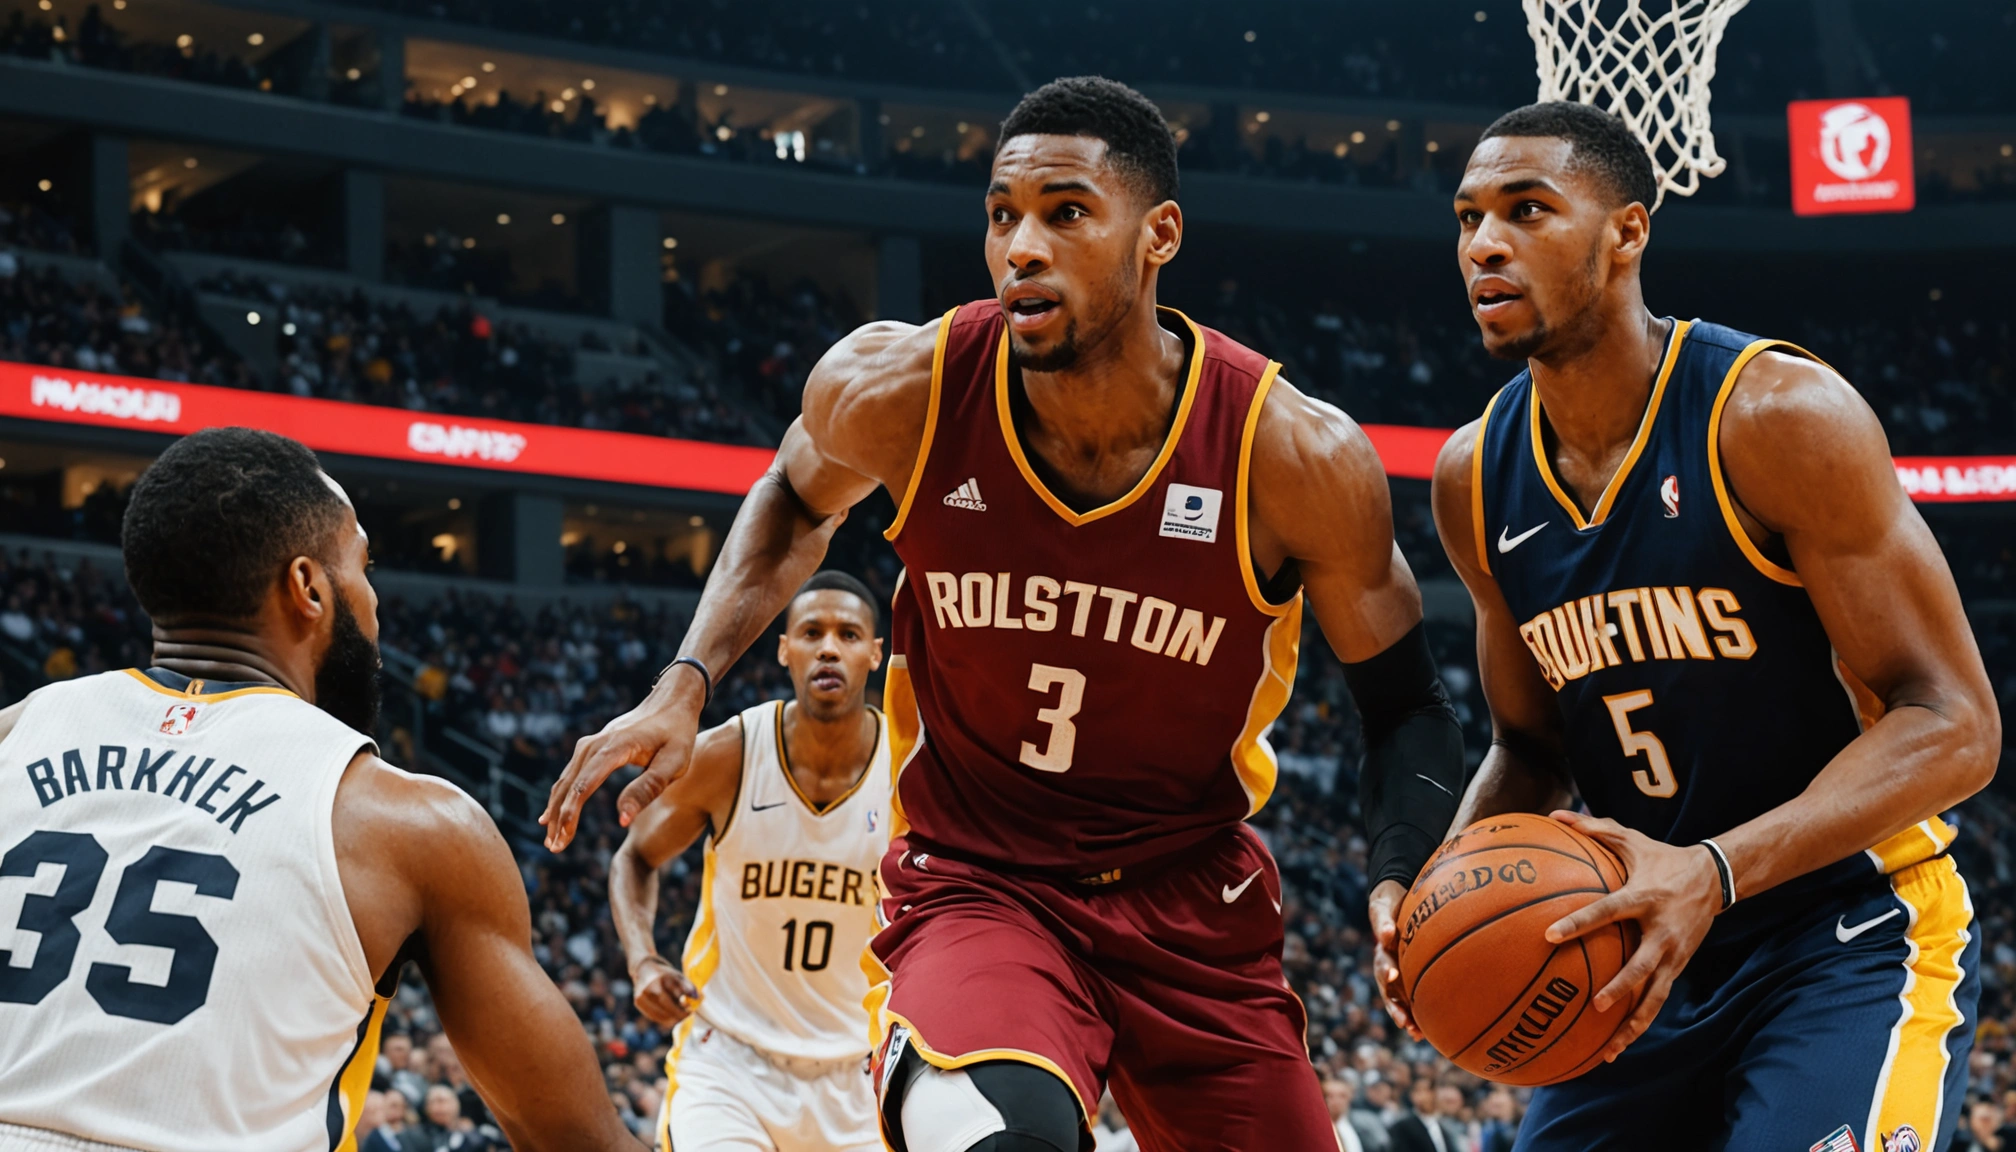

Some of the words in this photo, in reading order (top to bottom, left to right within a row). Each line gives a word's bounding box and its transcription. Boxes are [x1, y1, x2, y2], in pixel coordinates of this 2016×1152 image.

[1019, 663, 1086, 773] 3
[1602, 688, 1679, 798] 5
[0, 830, 241, 1025] 35
[741, 860, 880, 906] BUGER
[781, 918, 834, 972] 10
